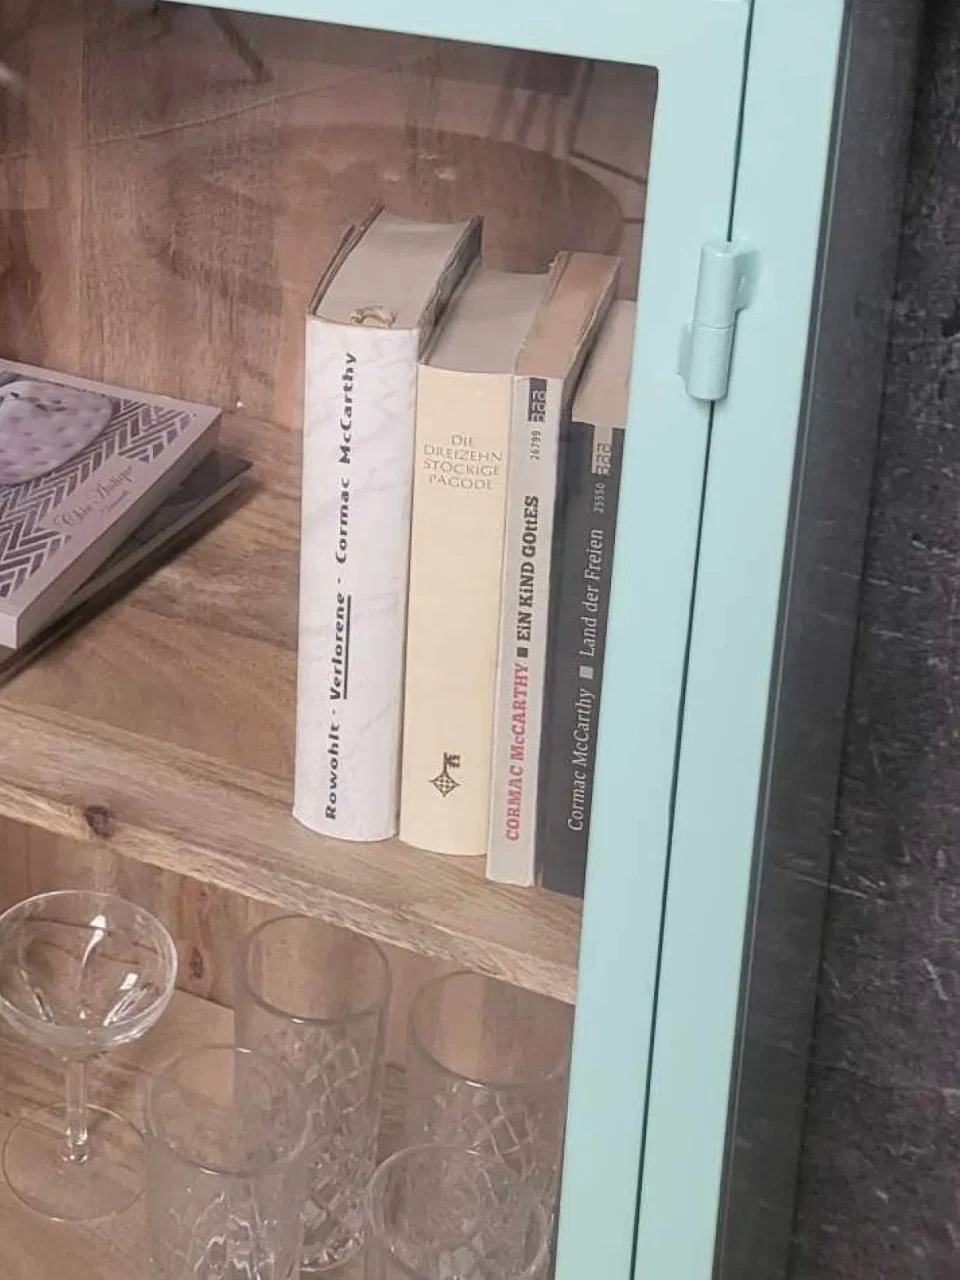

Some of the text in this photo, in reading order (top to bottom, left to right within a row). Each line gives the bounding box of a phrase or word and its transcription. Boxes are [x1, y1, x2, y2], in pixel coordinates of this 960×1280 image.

[429, 473, 494, 490] PAGODE
[451, 434, 477, 447] DIE
[325, 352, 358, 820] Rowohlt Verlorene Cormac McCarthy
[510, 663, 529, 762] McCARTHY
[567, 529, 604, 832] Cormac McCarthy Land der Freien
[505, 765, 524, 841] CORMAC
